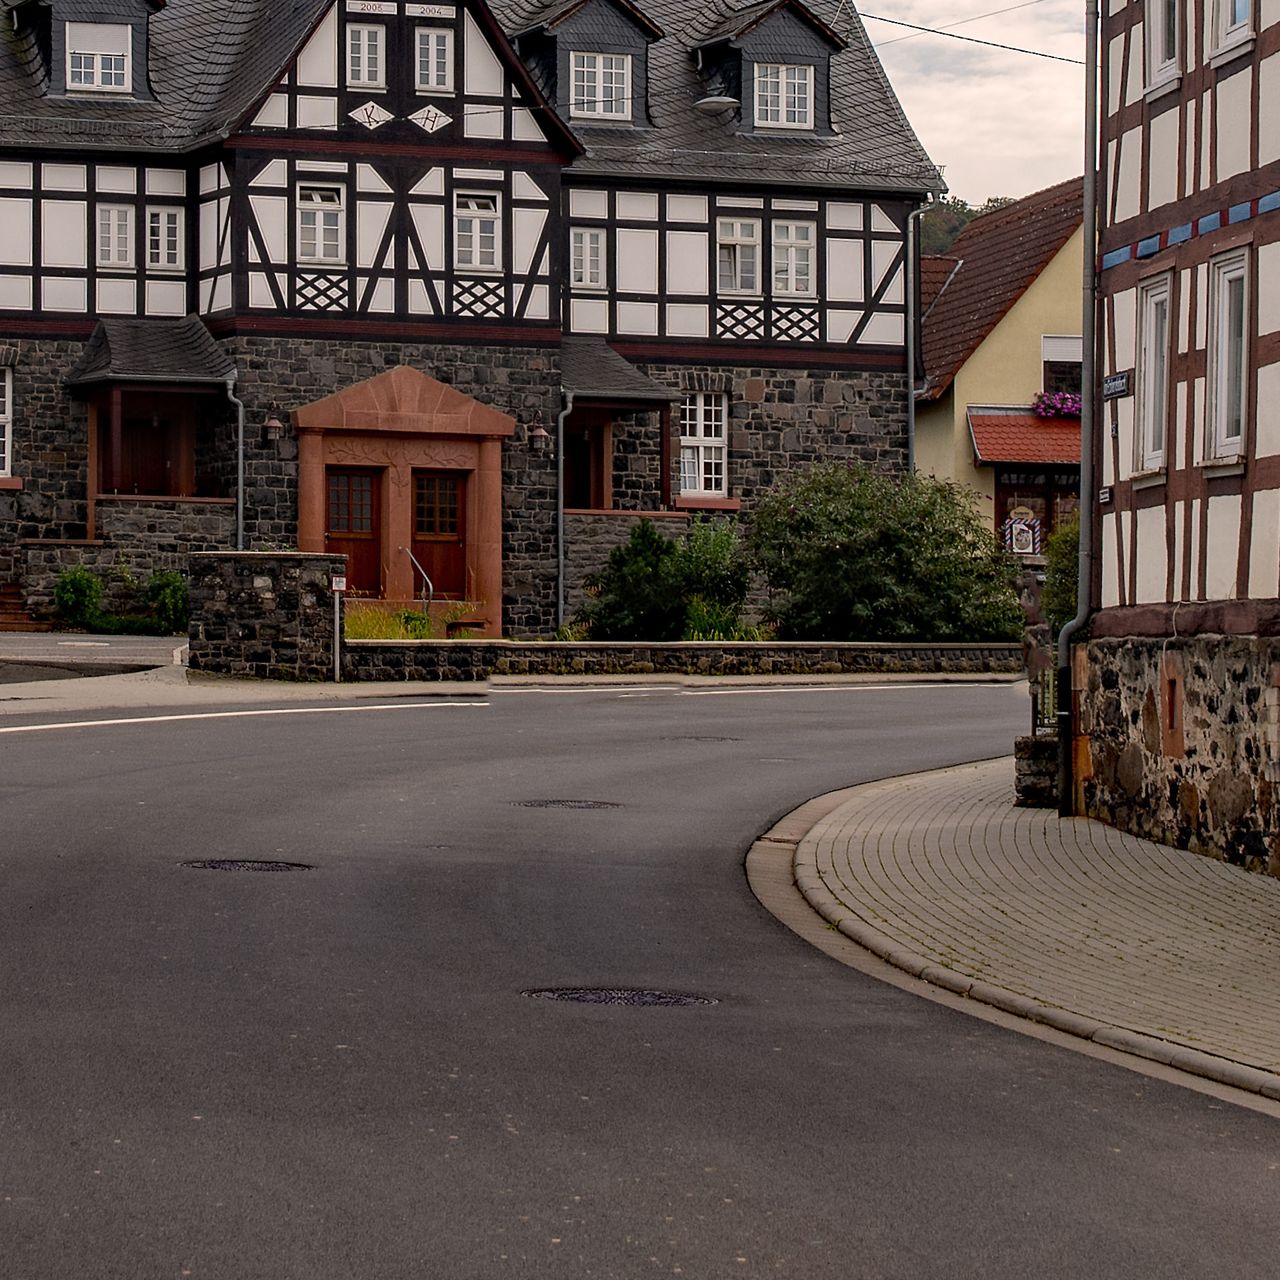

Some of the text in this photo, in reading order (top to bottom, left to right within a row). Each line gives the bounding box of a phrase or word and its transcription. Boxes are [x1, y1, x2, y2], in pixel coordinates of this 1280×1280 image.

[420, 6, 442, 15] 2004
[364, 105, 380, 127] K
[422, 109, 438, 131] H
